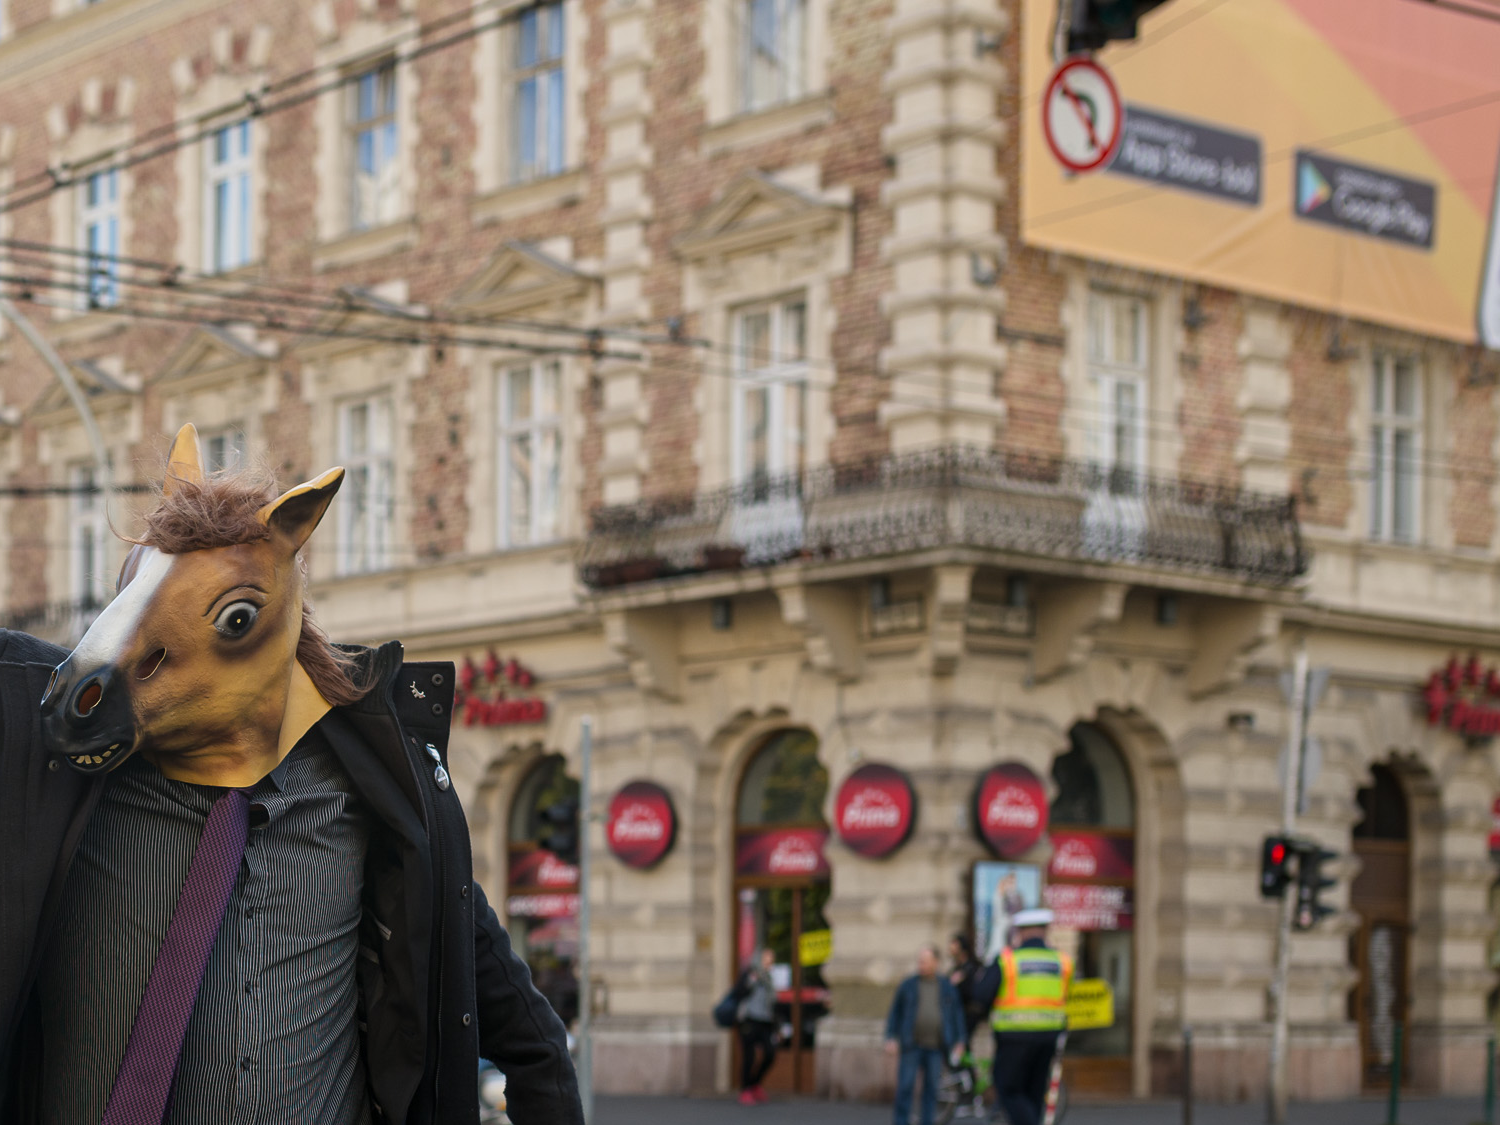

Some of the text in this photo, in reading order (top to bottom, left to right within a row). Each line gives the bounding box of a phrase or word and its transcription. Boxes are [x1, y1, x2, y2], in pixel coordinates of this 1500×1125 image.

[463, 694, 547, 728] Prima
[842, 803, 900, 830] Prima
[987, 800, 1039, 829] Prima
[613, 818, 664, 842] Prima
[769, 849, 818, 872] Prima
[1052, 852, 1097, 876] Prima
